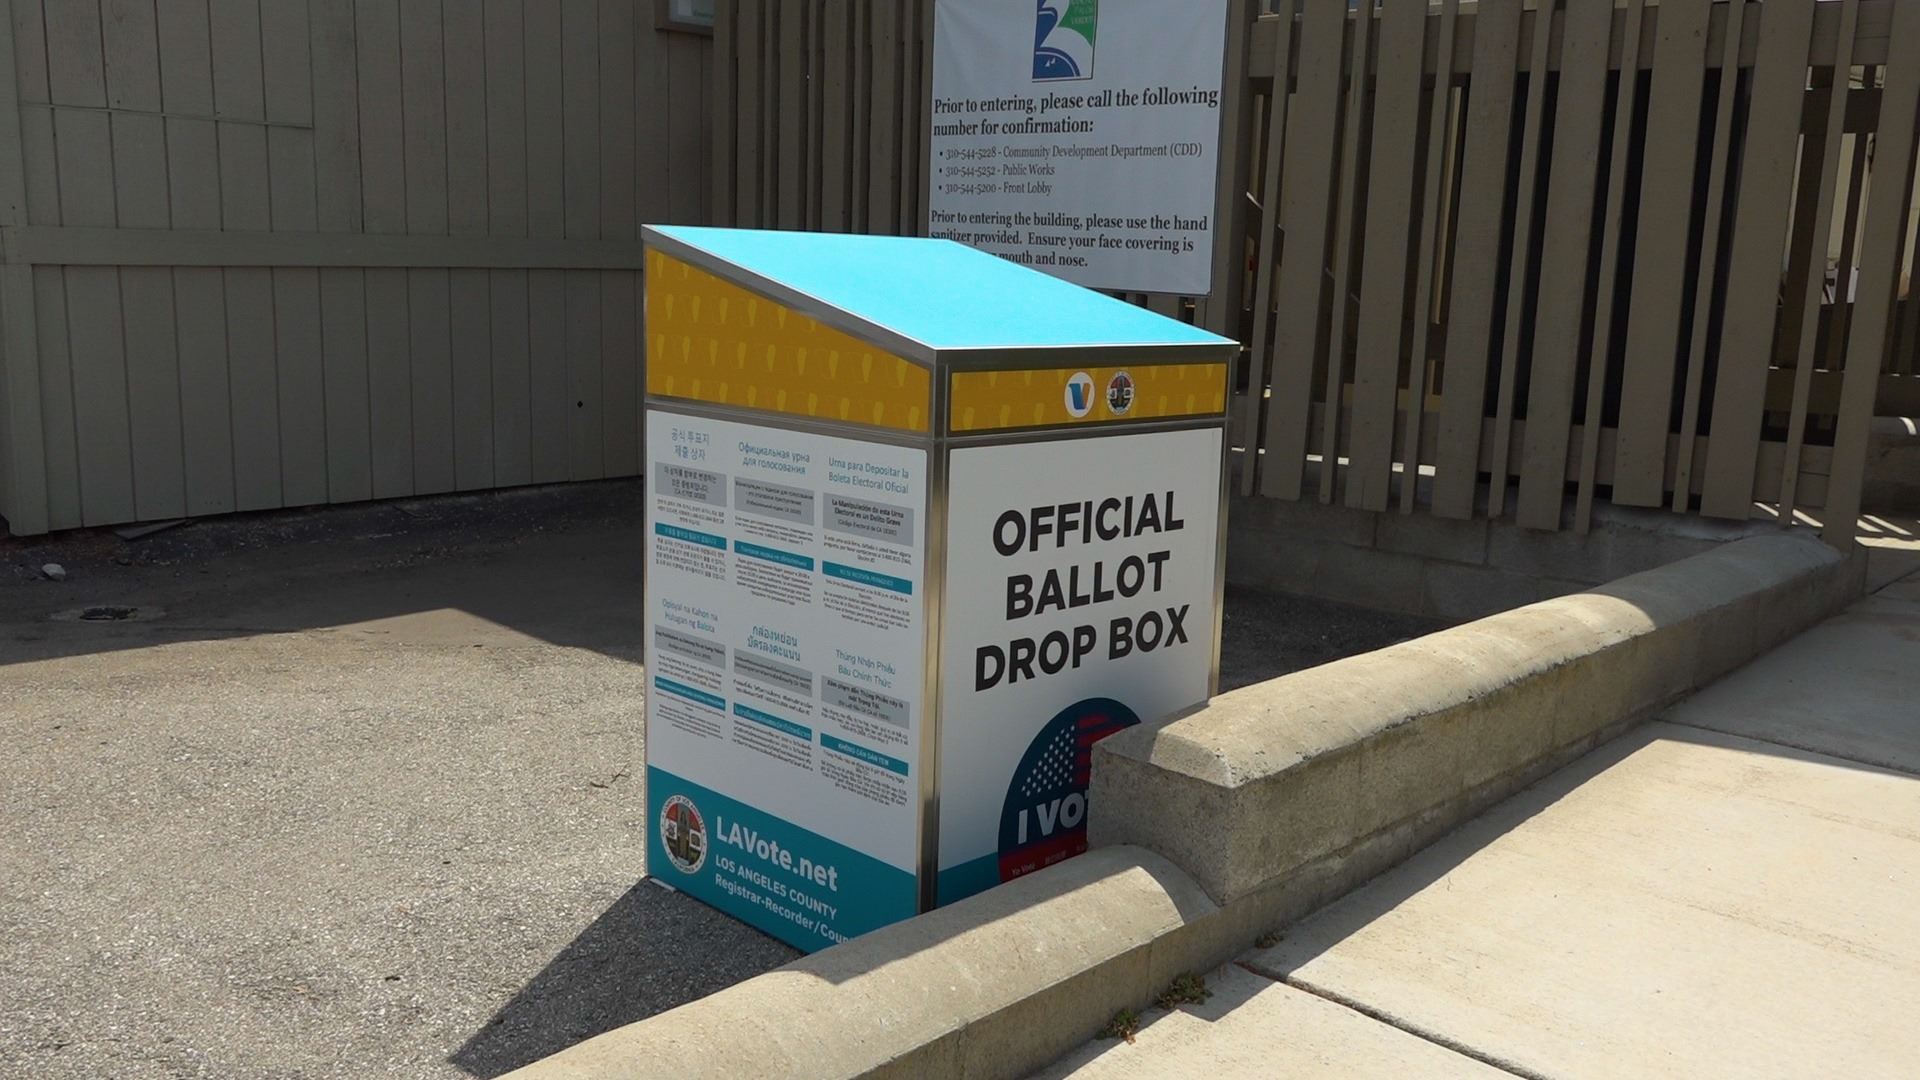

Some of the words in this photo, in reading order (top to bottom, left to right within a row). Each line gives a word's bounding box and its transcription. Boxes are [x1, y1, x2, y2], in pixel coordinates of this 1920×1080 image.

[934, 97, 963, 114] Prior
[966, 98, 977, 112] to
[980, 94, 1037, 114] entering,
[1040, 92, 1083, 114] please
[1086, 90, 1112, 108] call
[1116, 89, 1139, 107] the
[1142, 86, 1219, 108] following
[933, 119, 978, 136] number
[981, 119, 999, 135] for
[1002, 116, 1093, 135] confirmation:
[945, 146, 997, 160] 310-544-5228
[1003, 145, 1050, 160] Community
[1052, 144, 1108, 160] Development
[1111, 144, 1167, 159] Department
[1169, 142, 1203, 158] (CDD)
[945, 166, 996, 177] 310-544-5252
[1003, 163, 1027, 175] Public
[1029, 163, 1055, 176] Works
[945, 183, 997, 195] 310-544-5200
[1003, 181, 1025, 193] Front
[1027, 181, 1052, 196] Lobby
[931, 209, 956, 222] Prior
[958, 211, 967, 223] to
[969, 211, 1012, 228] entering
[1014, 212, 1031, 226] the
[1034, 212, 1083, 230] building,
[1086, 213, 1123, 231] please
[1126, 217, 1147, 229] use
[1150, 215, 1171, 230] the
[1173, 215, 1208, 231] hand
[931, 228, 972, 242] sanitizer
[974, 230, 1023, 246] provided.
[1028, 231, 1066, 246] Ensure
[1069, 236, 1096, 250] your
[1098, 233, 1122, 248] face
[1125, 235, 1180, 255] covering
[1183, 237, 1194, 251] is
[1035, 251, 1056, 265] and
[1058, 255, 1088, 268] nose.
[738, 441, 790, 459] Официальная
[791, 452, 810, 463] урна
[742, 456, 756, 467] для
[758, 458, 806, 474] голосования
[828, 457, 846, 469] Urna
[847, 462, 864, 472] para
[865, 463, 900, 477] Depositar
[902, 468, 909, 479] la
[828, 472, 851, 484] Boleta
[852, 475, 884, 490] Electoral
[884, 481, 909, 494] Oficial
[993, 490, 1184, 556] OFFICIAL
[1006, 550, 1170, 620] BALLOT
[975, 624, 1097, 692] DROP
[1108, 604, 1190, 660] BOX
[1018, 808, 1028, 845] I
[716, 816, 838, 892] LAVote.net
[715, 854, 736, 873] LOS
[737, 865, 787, 897] ANGELES
[789, 888, 837, 920] COUNTY
[715, 873, 850, 944] Registrar-Recorder/Coun
